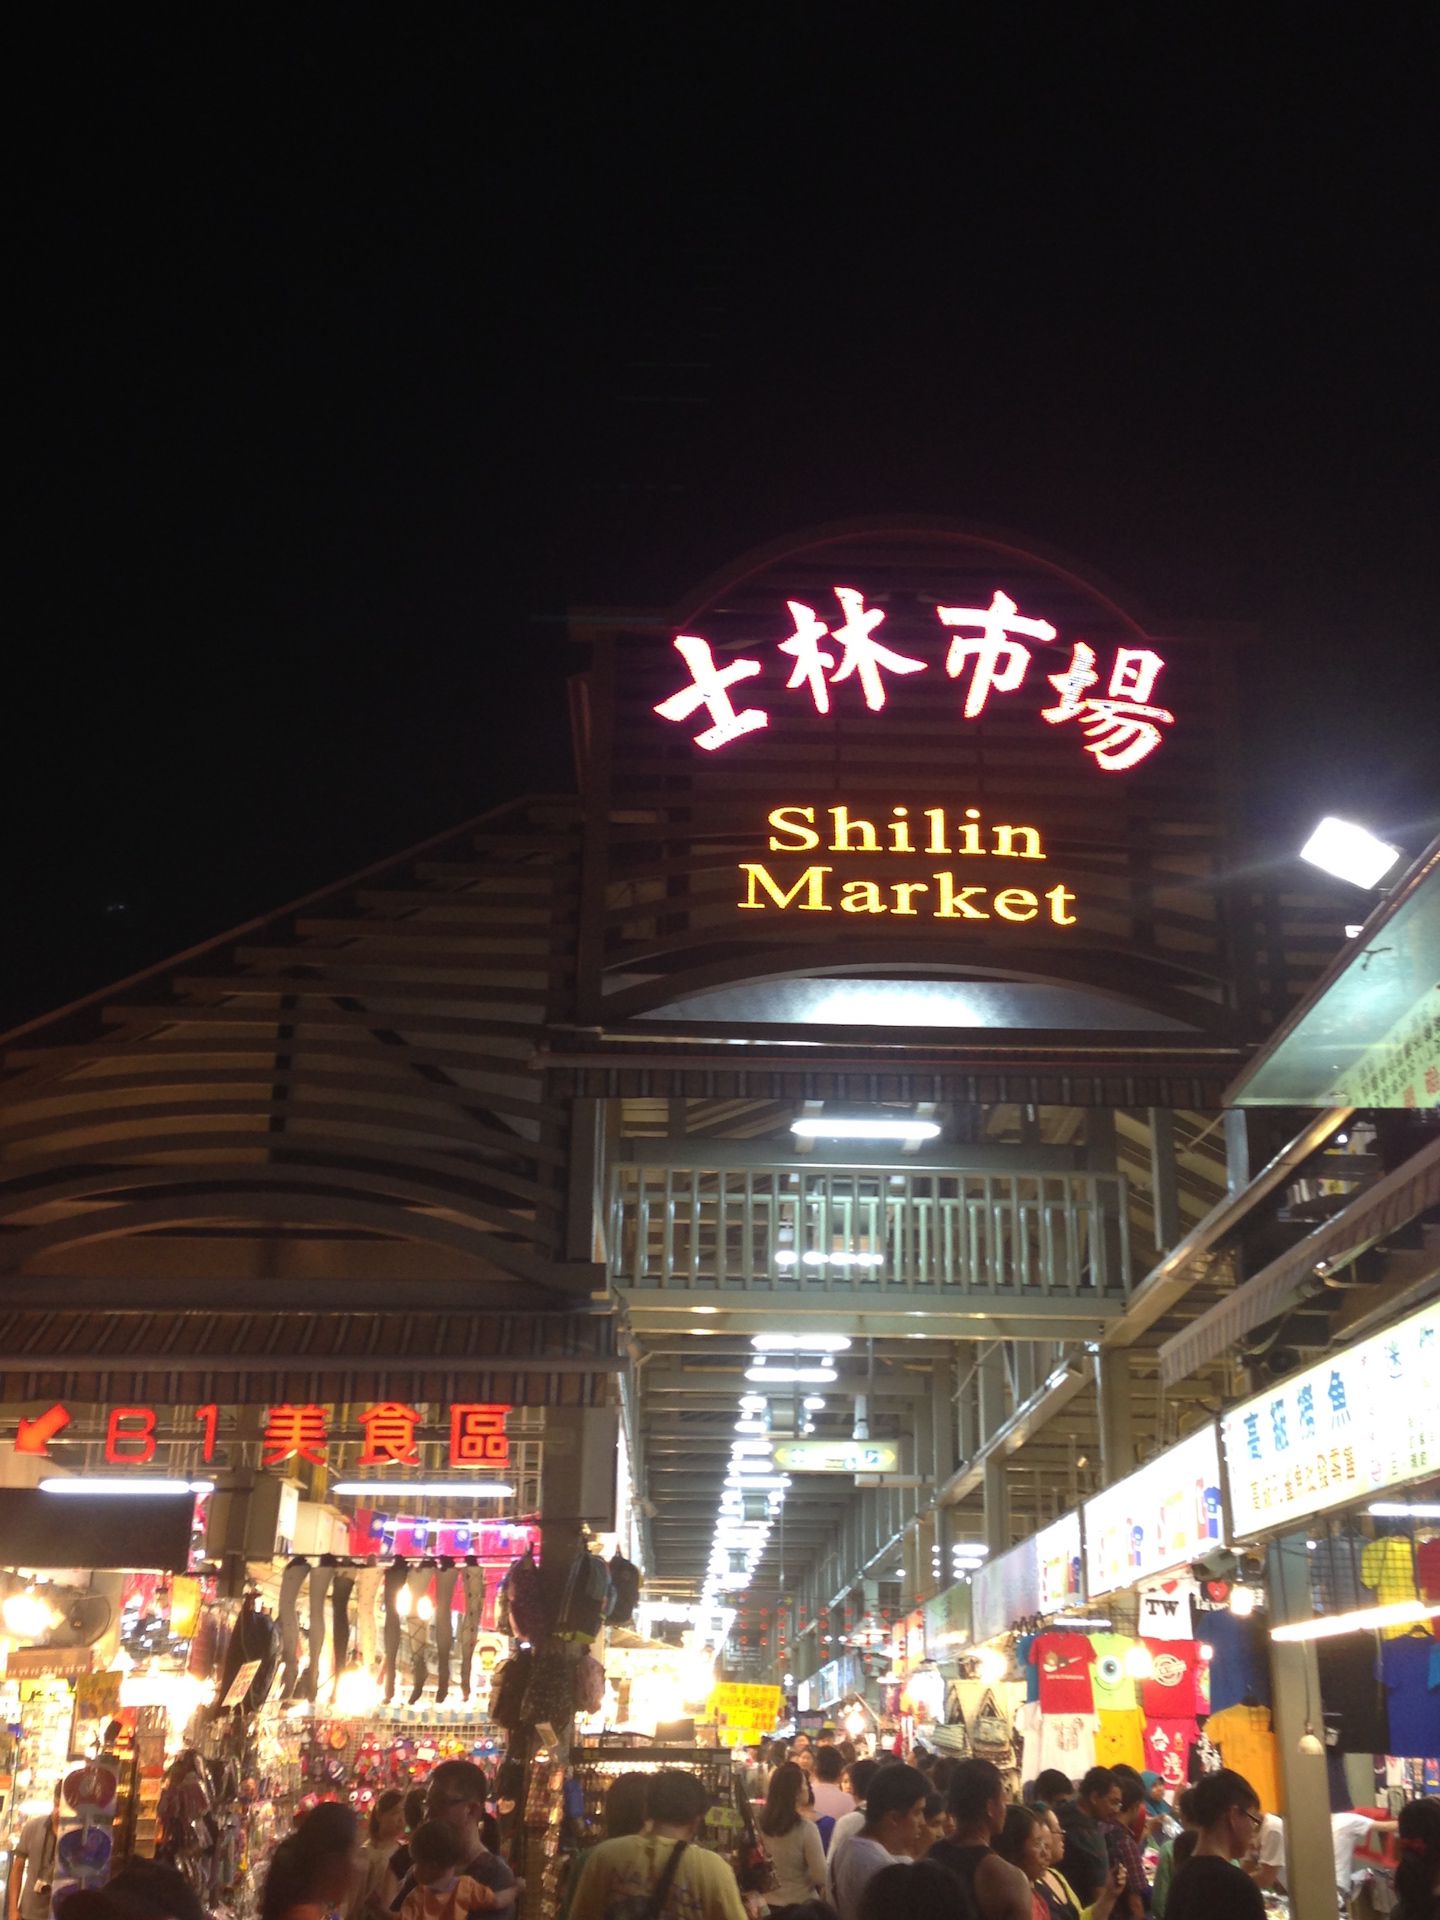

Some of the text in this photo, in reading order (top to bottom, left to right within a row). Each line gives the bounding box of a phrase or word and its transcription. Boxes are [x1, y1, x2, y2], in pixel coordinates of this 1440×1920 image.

[653, 587, 1174, 770] 士林市場
[768, 806, 1046, 859] Shilin
[738, 864, 1076, 925] Market
[263, 1403, 512, 1468] 美食區
[1146, 1599, 1180, 1616] TW
